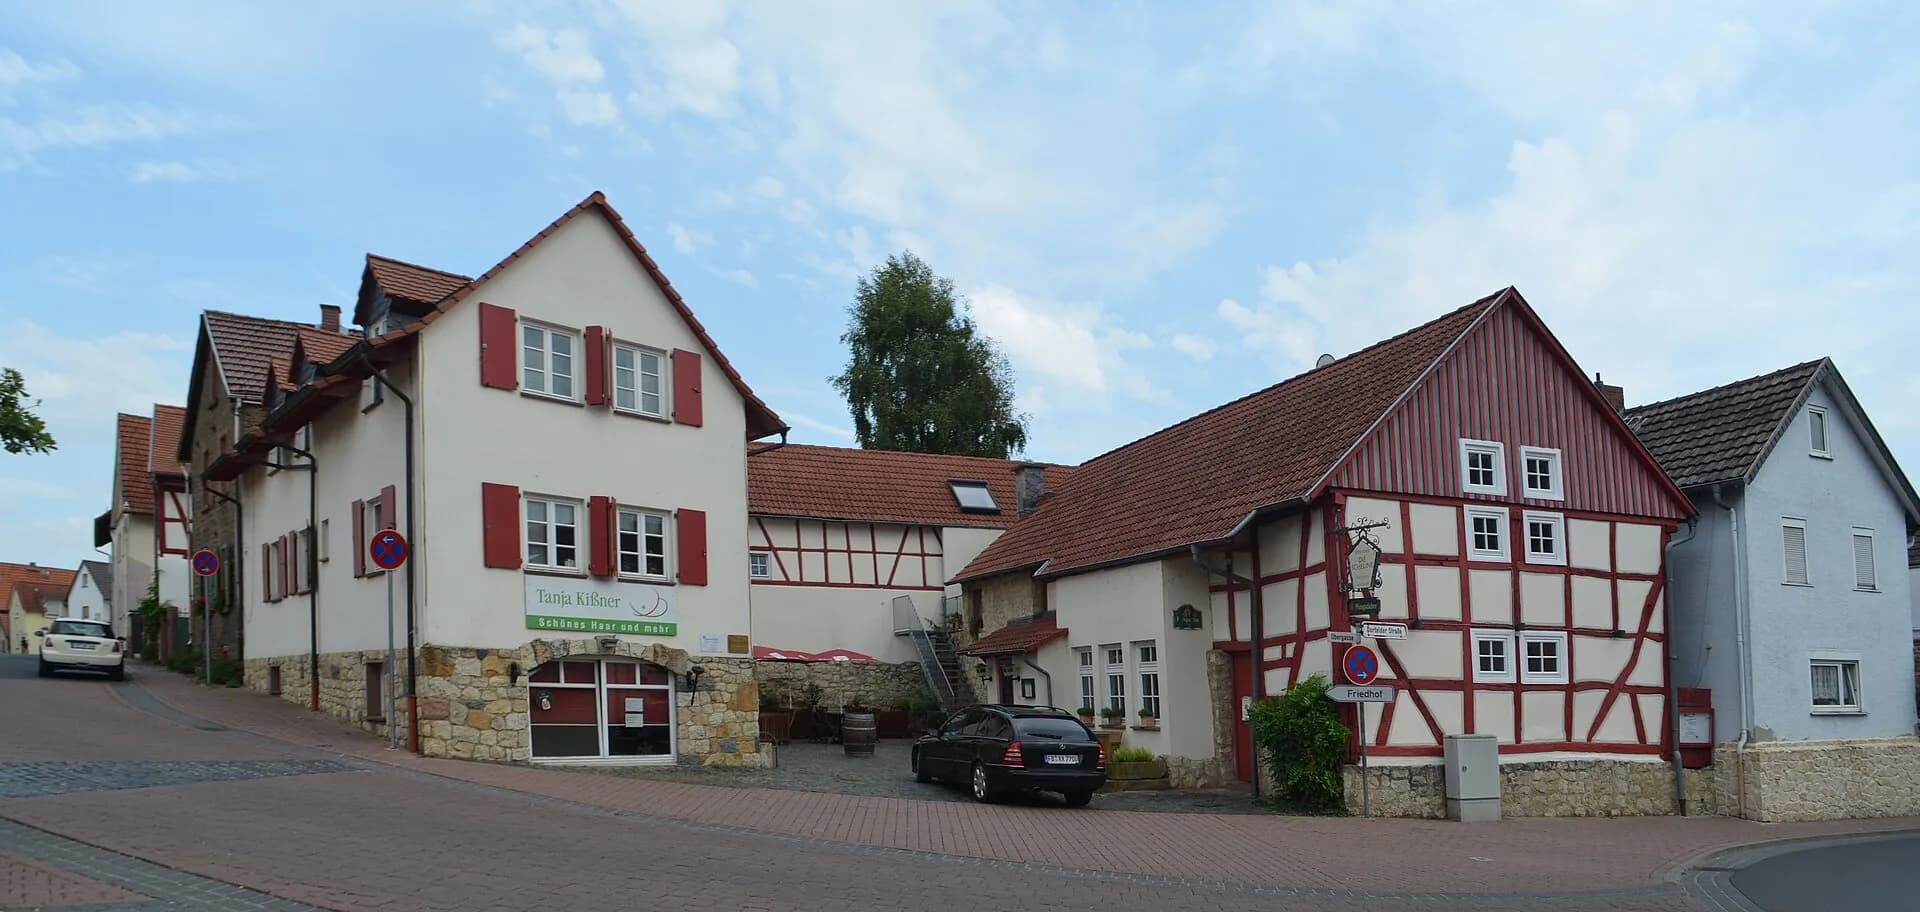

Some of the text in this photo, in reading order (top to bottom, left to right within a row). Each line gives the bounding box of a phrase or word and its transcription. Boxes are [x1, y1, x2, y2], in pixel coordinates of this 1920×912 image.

[536, 588, 621, 608] Tanja Kißner
[538, 617, 586, 629] Schönes
[591, 620, 616, 631] Haar
[644, 625, 670, 634] mehr
[1347, 689, 1383, 698] Friedhof
